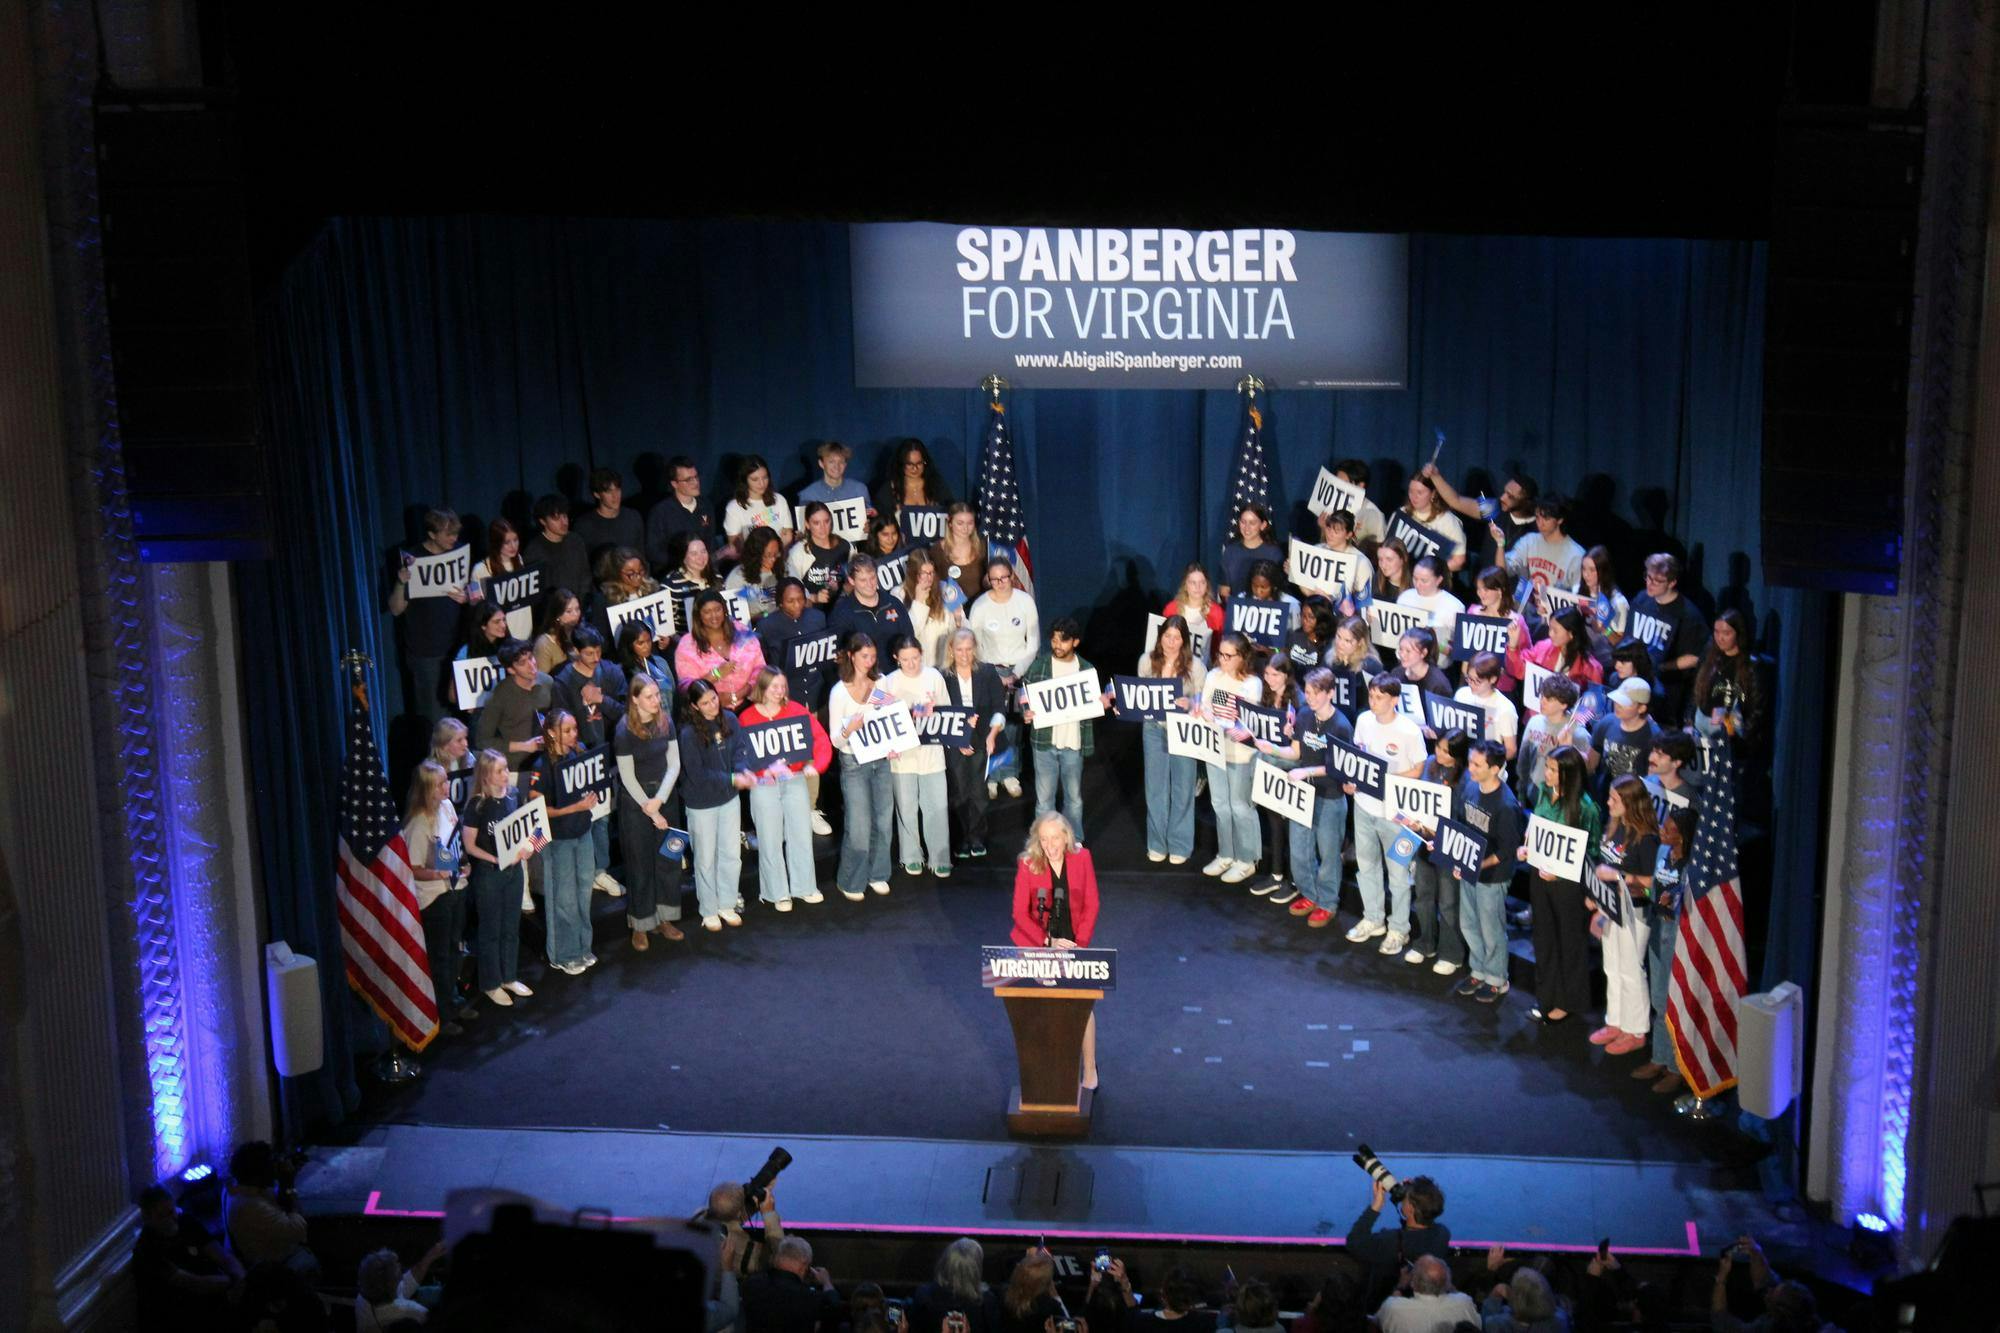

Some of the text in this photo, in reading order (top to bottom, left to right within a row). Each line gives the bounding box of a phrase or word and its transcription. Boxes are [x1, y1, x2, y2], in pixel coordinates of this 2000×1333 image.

[956, 228, 1298, 282] SPANBERGER
[963, 287, 1295, 340] FOR VIRGINIA
[1015, 351, 1242, 371] www.AbigailSpanberger.com
[1317, 477, 1354, 510] VOTE
[832, 508, 857, 530] TE
[910, 513, 948, 536] VOT
[418, 555, 466, 586] VOTE
[1299, 551, 1346, 582] VOTE
[494, 570, 540, 605] VOTE
[1233, 605, 1282, 635] VOTE
[1633, 613, 1672, 650] VOTE
[795, 635, 838, 667] VOTE
[1462, 622, 1507, 654] VOTE
[465, 663, 506, 693] VOT
[1038, 681, 1093, 713] VOTE
[1122, 684, 1175, 710] VOTE
[856, 713, 907, 747] VOTE
[916, 713, 966, 736] VOTE
[1432, 702, 1478, 738] VOTE
[749, 724, 807, 758] VOTE
[1177, 722, 1220, 754] VOTE
[562, 758, 606, 793] VOTE
[1332, 745, 1380, 787] VOTE
[1263, 771, 1306, 811] VOTE
[1395, 785, 1442, 816] VOTE
[1442, 826, 1481, 871] VOTE
[1536, 827, 1578, 865] VOTE
[1585, 867, 1616, 913] VOTE
[991, 959, 1109, 980] VIRGINIA VOTES
[1054, 1255, 1083, 1276] TE
